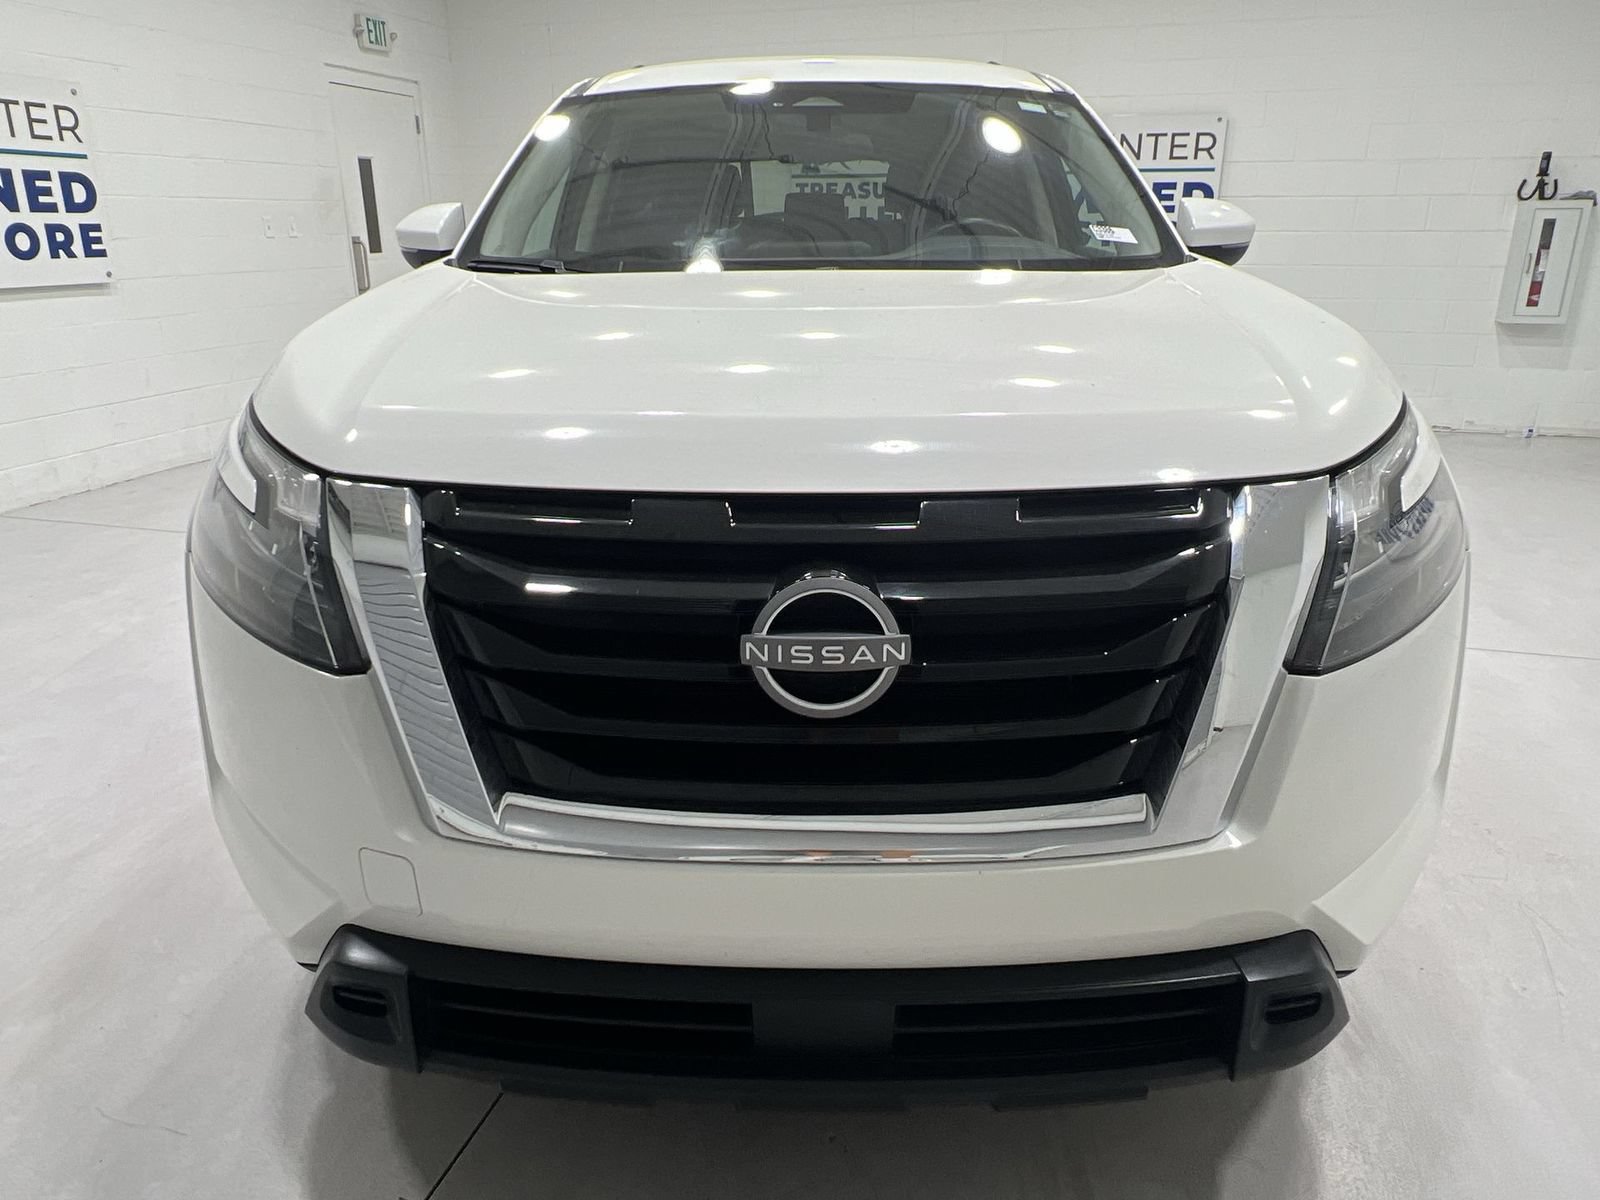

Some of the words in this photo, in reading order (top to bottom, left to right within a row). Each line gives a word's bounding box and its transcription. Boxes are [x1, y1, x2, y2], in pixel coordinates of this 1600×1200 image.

[366, 17, 387, 47] EXIT
[0, 98, 83, 143] TER
[4, 222, 108, 261] ORE
[745, 641, 905, 665] NISSAN
